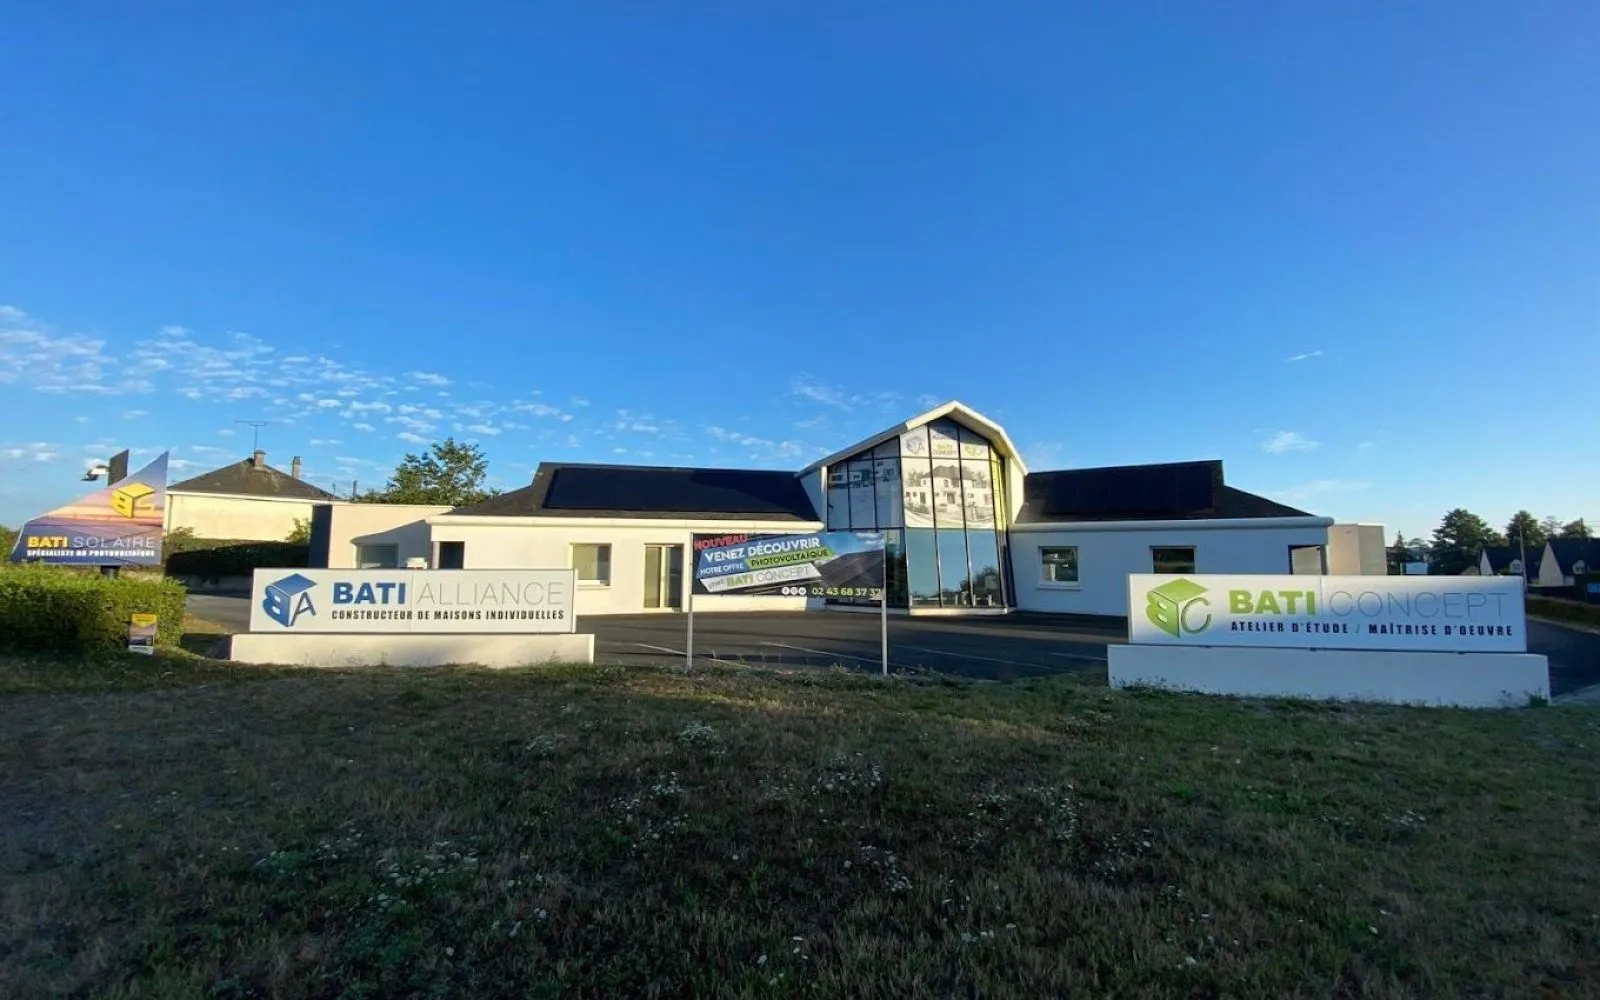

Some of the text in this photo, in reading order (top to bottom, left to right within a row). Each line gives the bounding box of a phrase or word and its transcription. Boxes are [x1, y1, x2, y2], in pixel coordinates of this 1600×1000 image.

[27, 536, 156, 548] BATI SOLAIRE
[694, 534, 749, 549] NOUVEAU
[704, 537, 821, 563] VENEZ DÉCOUVRIR
[756, 566, 809, 582] CONCEPT
[332, 581, 564, 606] BATI ALLIANCE
[812, 587, 824, 596] 02
[826, 587, 839, 596] 43
[841, 587, 854, 596] 68
[855, 587, 868, 596] 37
[1228, 589, 1510, 619] BATI CONCEPT
[331, 610, 565, 620] CONSTRUCTEUR DE MAISONS INDIVIDUELLES
[1231, 621, 1284, 633] ATELIER
[1368, 622, 1438, 636] MAÎTRISE
[1444, 624, 1513, 637] D'OEUVRE
